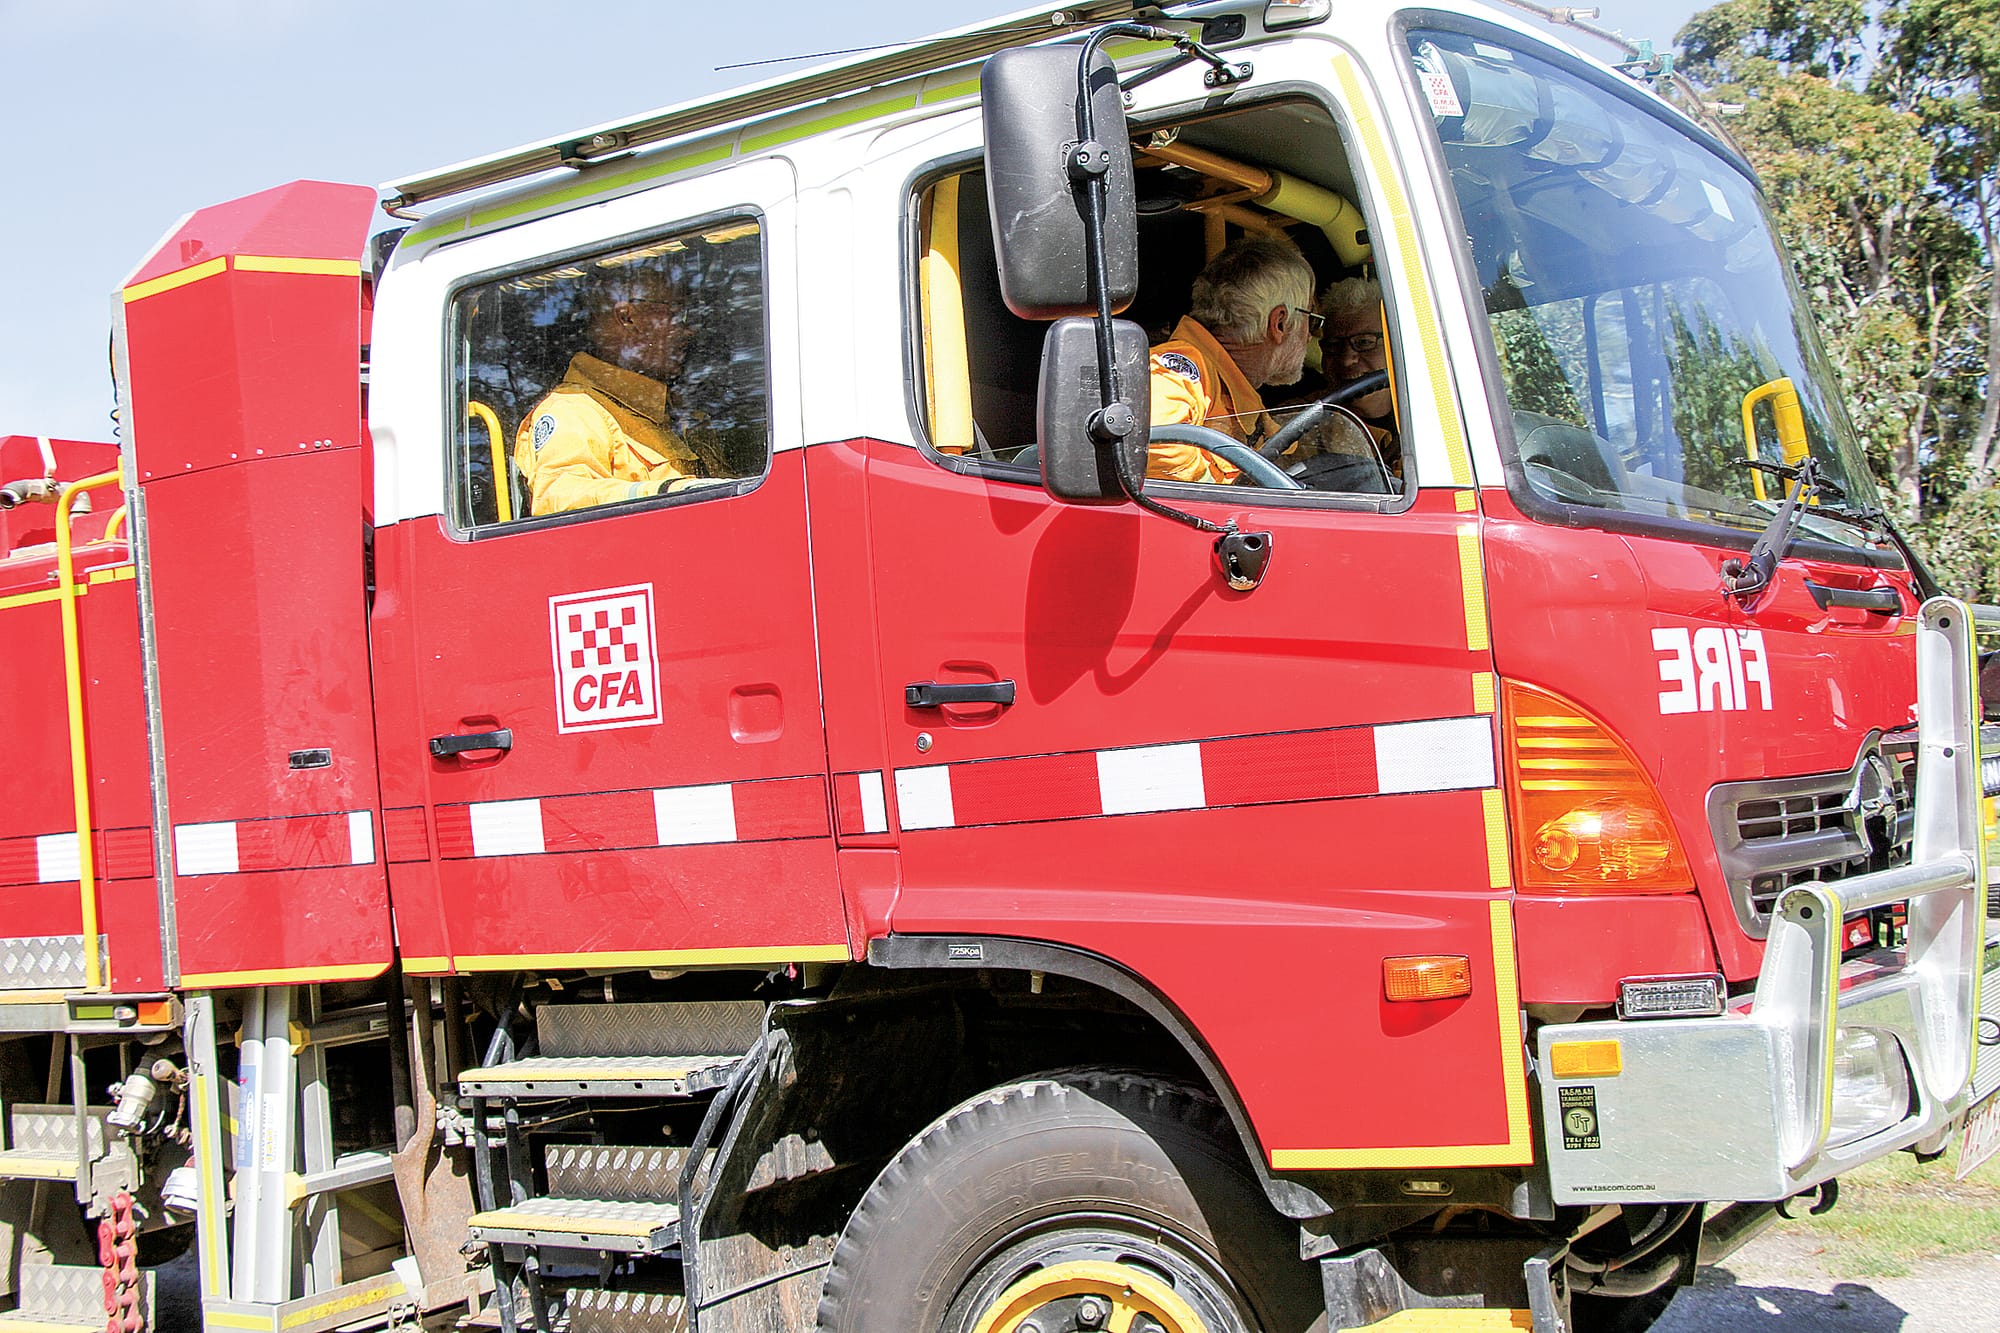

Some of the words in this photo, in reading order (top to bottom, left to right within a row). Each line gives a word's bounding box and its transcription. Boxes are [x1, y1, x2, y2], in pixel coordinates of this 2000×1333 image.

[573, 669, 644, 712] CFA
[950, 947, 980, 957] 725Kpa
[1571, 1183, 1656, 1192] www.tascom.com.au
